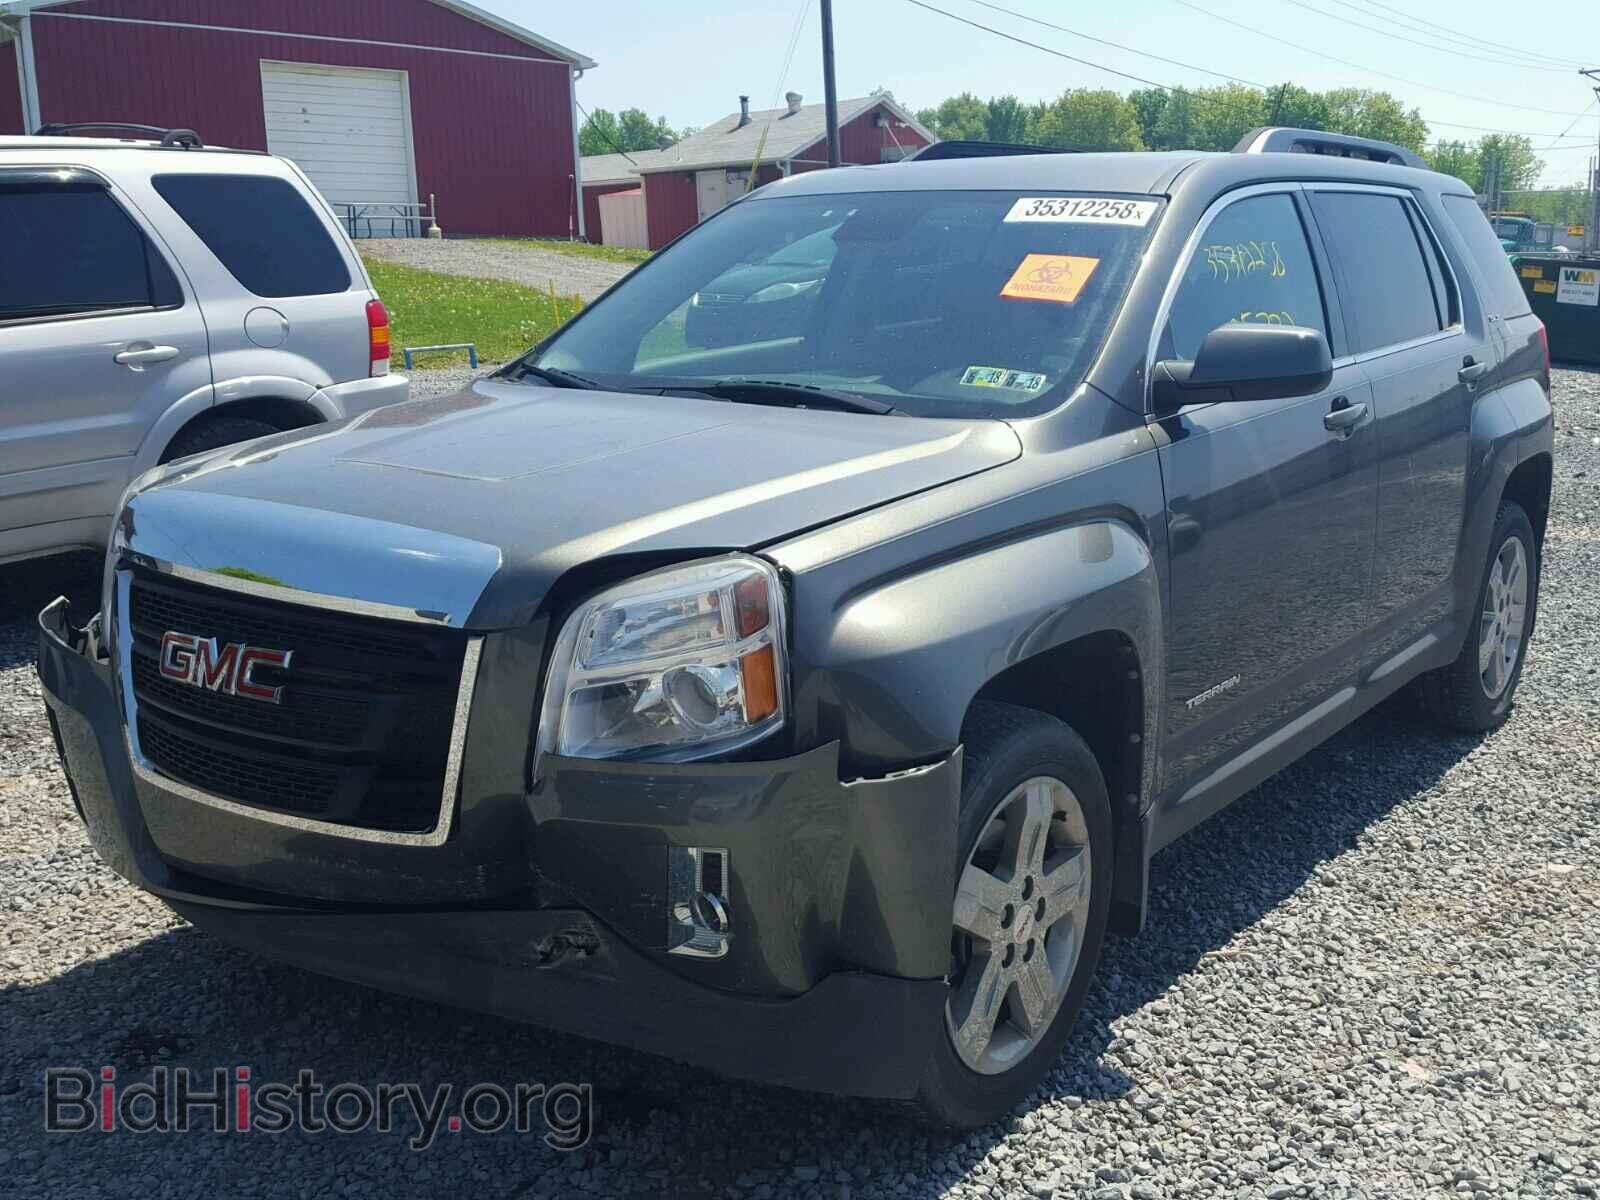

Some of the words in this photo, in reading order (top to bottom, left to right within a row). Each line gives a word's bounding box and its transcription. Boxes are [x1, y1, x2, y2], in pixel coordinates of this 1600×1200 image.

[1564, 270, 1596, 284] WM
[159, 629, 294, 704] GMC
[1185, 673, 1241, 709] TERRAIN
